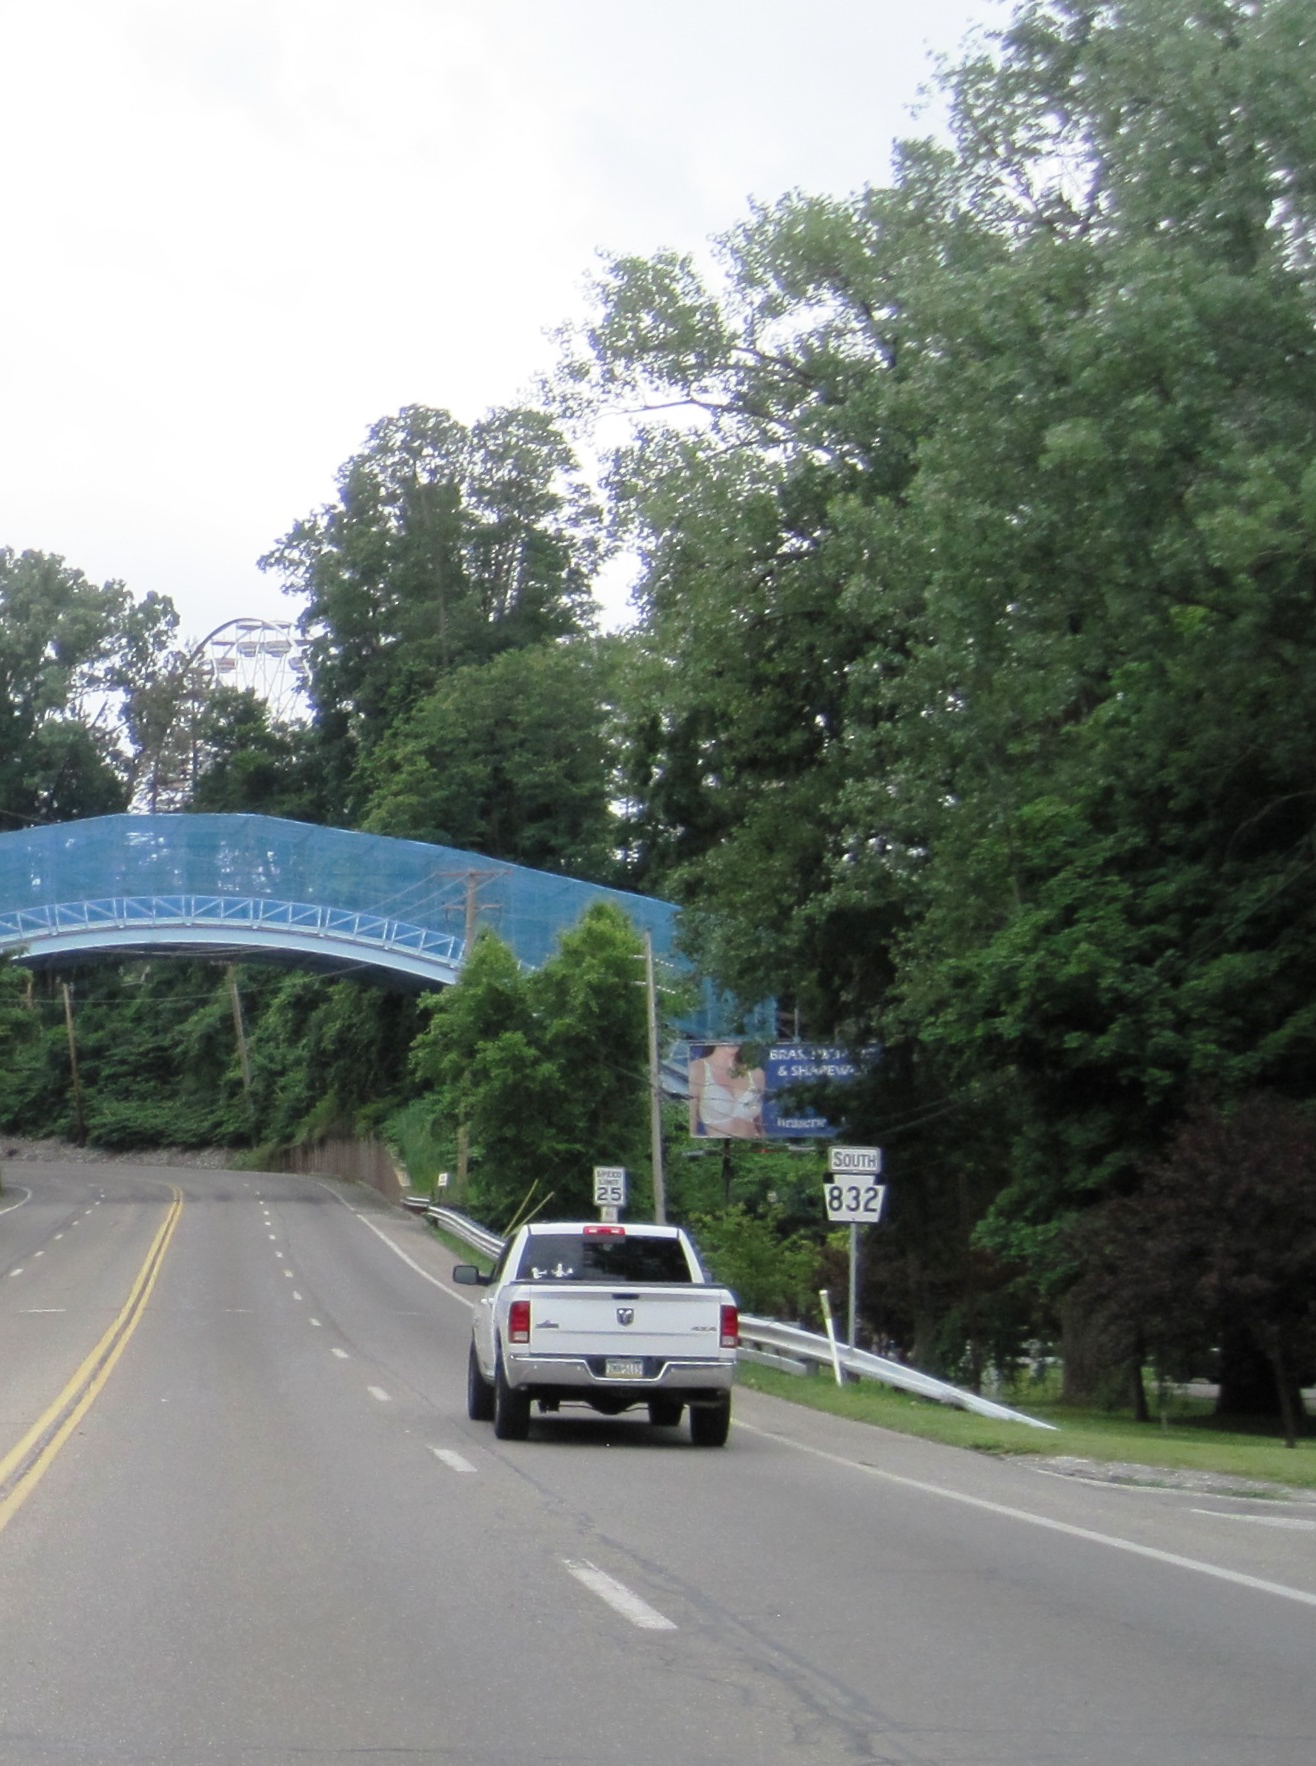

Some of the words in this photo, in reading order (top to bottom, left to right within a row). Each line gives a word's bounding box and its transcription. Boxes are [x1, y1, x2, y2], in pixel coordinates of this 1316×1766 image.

[833, 1151, 876, 1168] SOUTH
[597, 1187, 621, 1201] 25
[829, 1186, 878, 1212] 832
